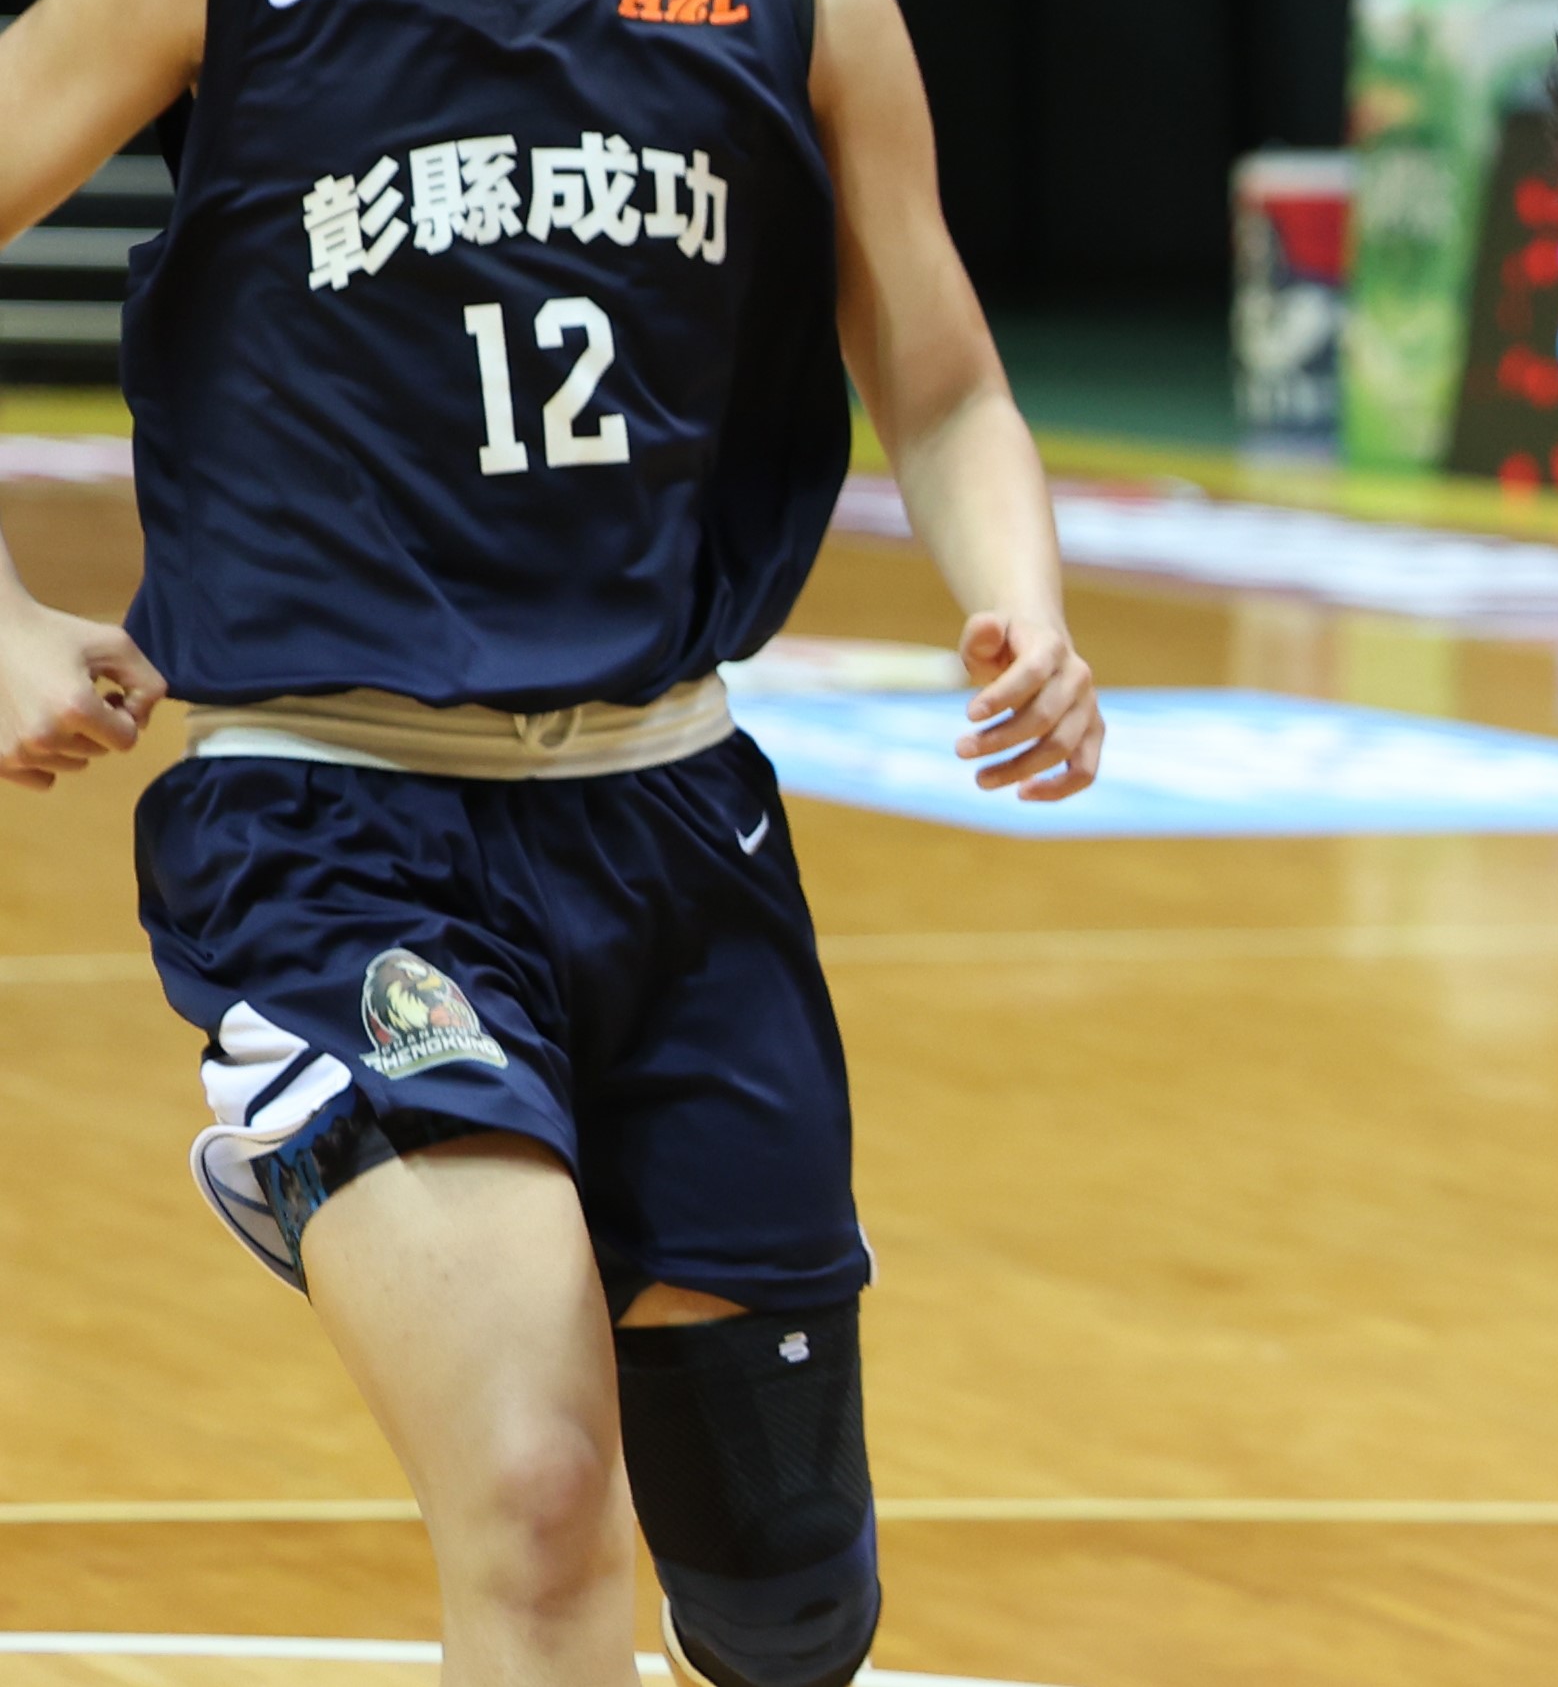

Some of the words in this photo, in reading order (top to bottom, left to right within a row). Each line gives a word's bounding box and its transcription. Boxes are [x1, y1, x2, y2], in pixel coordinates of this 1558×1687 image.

[302, 131, 728, 291] 彰縣成功
[463, 296, 631, 476] 12
